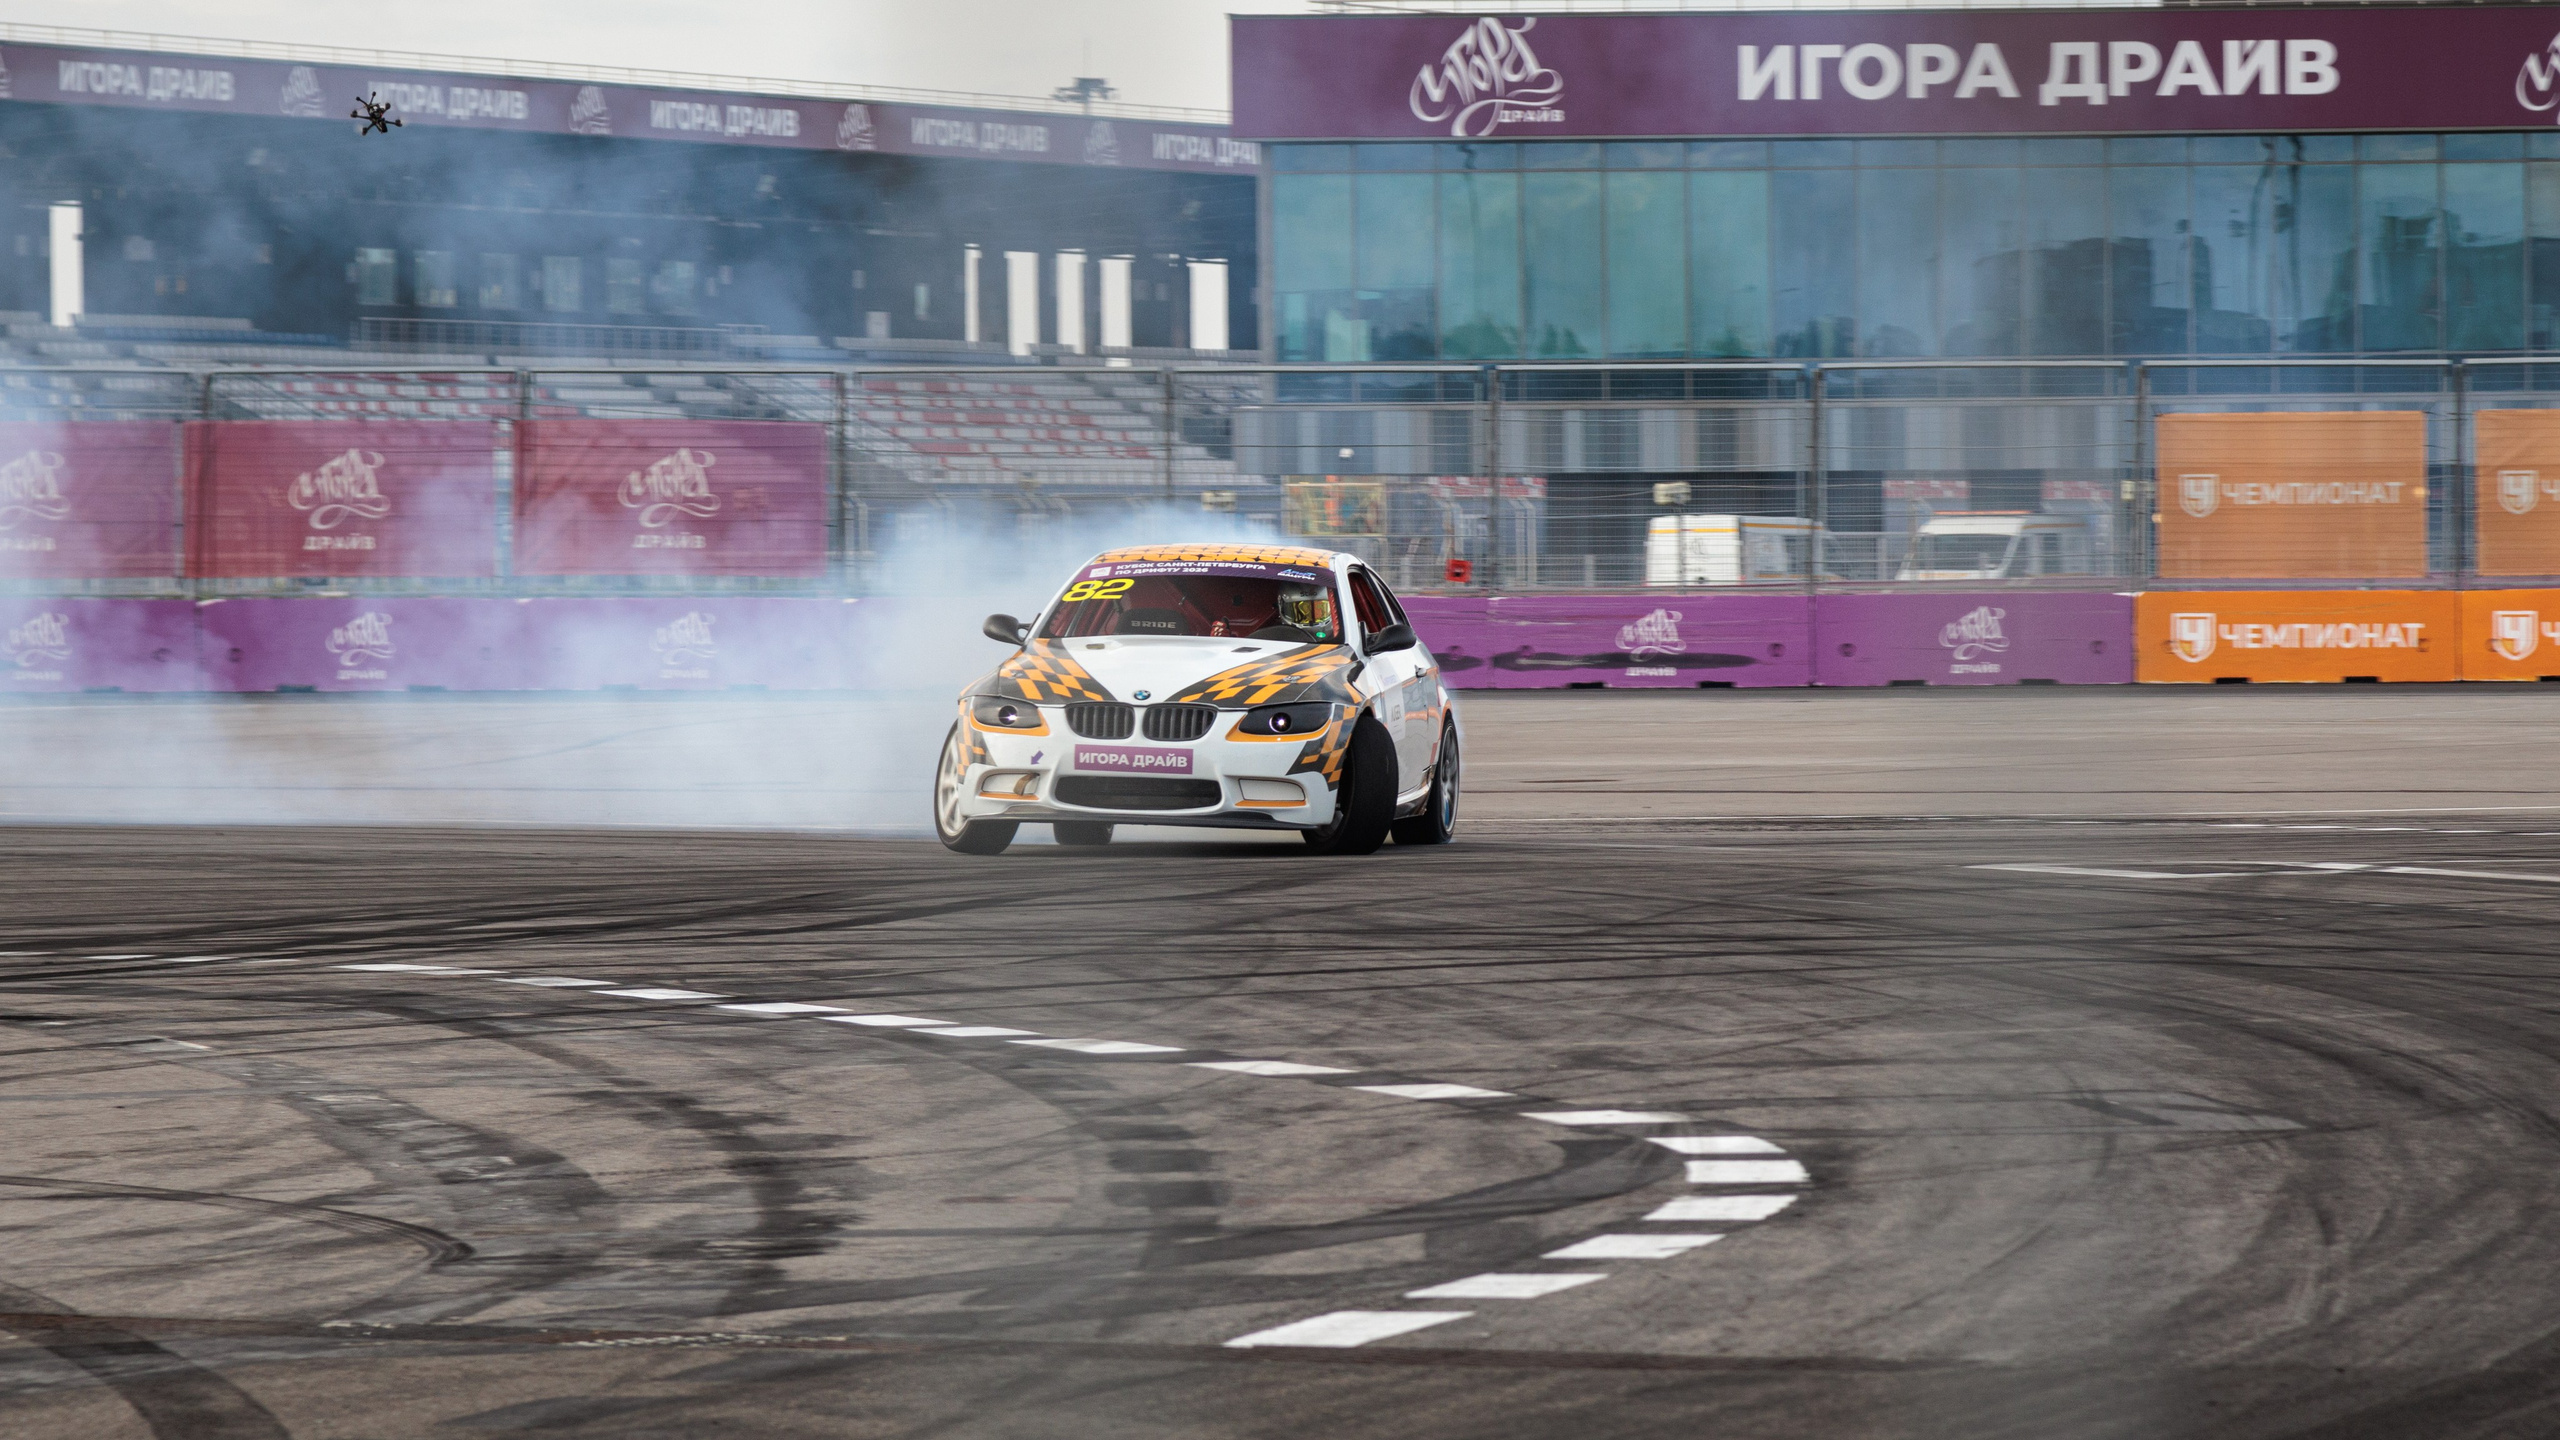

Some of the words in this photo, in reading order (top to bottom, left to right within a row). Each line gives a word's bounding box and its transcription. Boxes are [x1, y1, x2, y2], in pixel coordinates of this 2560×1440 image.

[58, 60, 144, 96] ИГОРА
[1737, 42, 2021, 100] ИГОРА
[2039, 38, 2341, 106] ДРАЙВ
[650, 100, 723, 132] ИГОРА
[1497, 107, 1566, 123] ДРАЙВ
[911, 117, 978, 148] ИГОРА
[1152, 133, 1214, 163] ИГОРА
[2222, 481, 2406, 505] ЧЕМПИОНАТ
[1116, 562, 1154, 570] КУБОК
[1156, 561, 1266, 570] САНКТ-ПЕТЕРБУРГА
[1133, 567, 1181, 575] ДРИФТУ
[1061, 578, 1135, 602] 82
[1131, 620, 1177, 629] BRIDE
[2219, 622, 2426, 648] ЧЕМПИОНАТ
[1079, 752, 1129, 765] ИГОРА
[1132, 753, 1188, 768] ДРАЙВ
